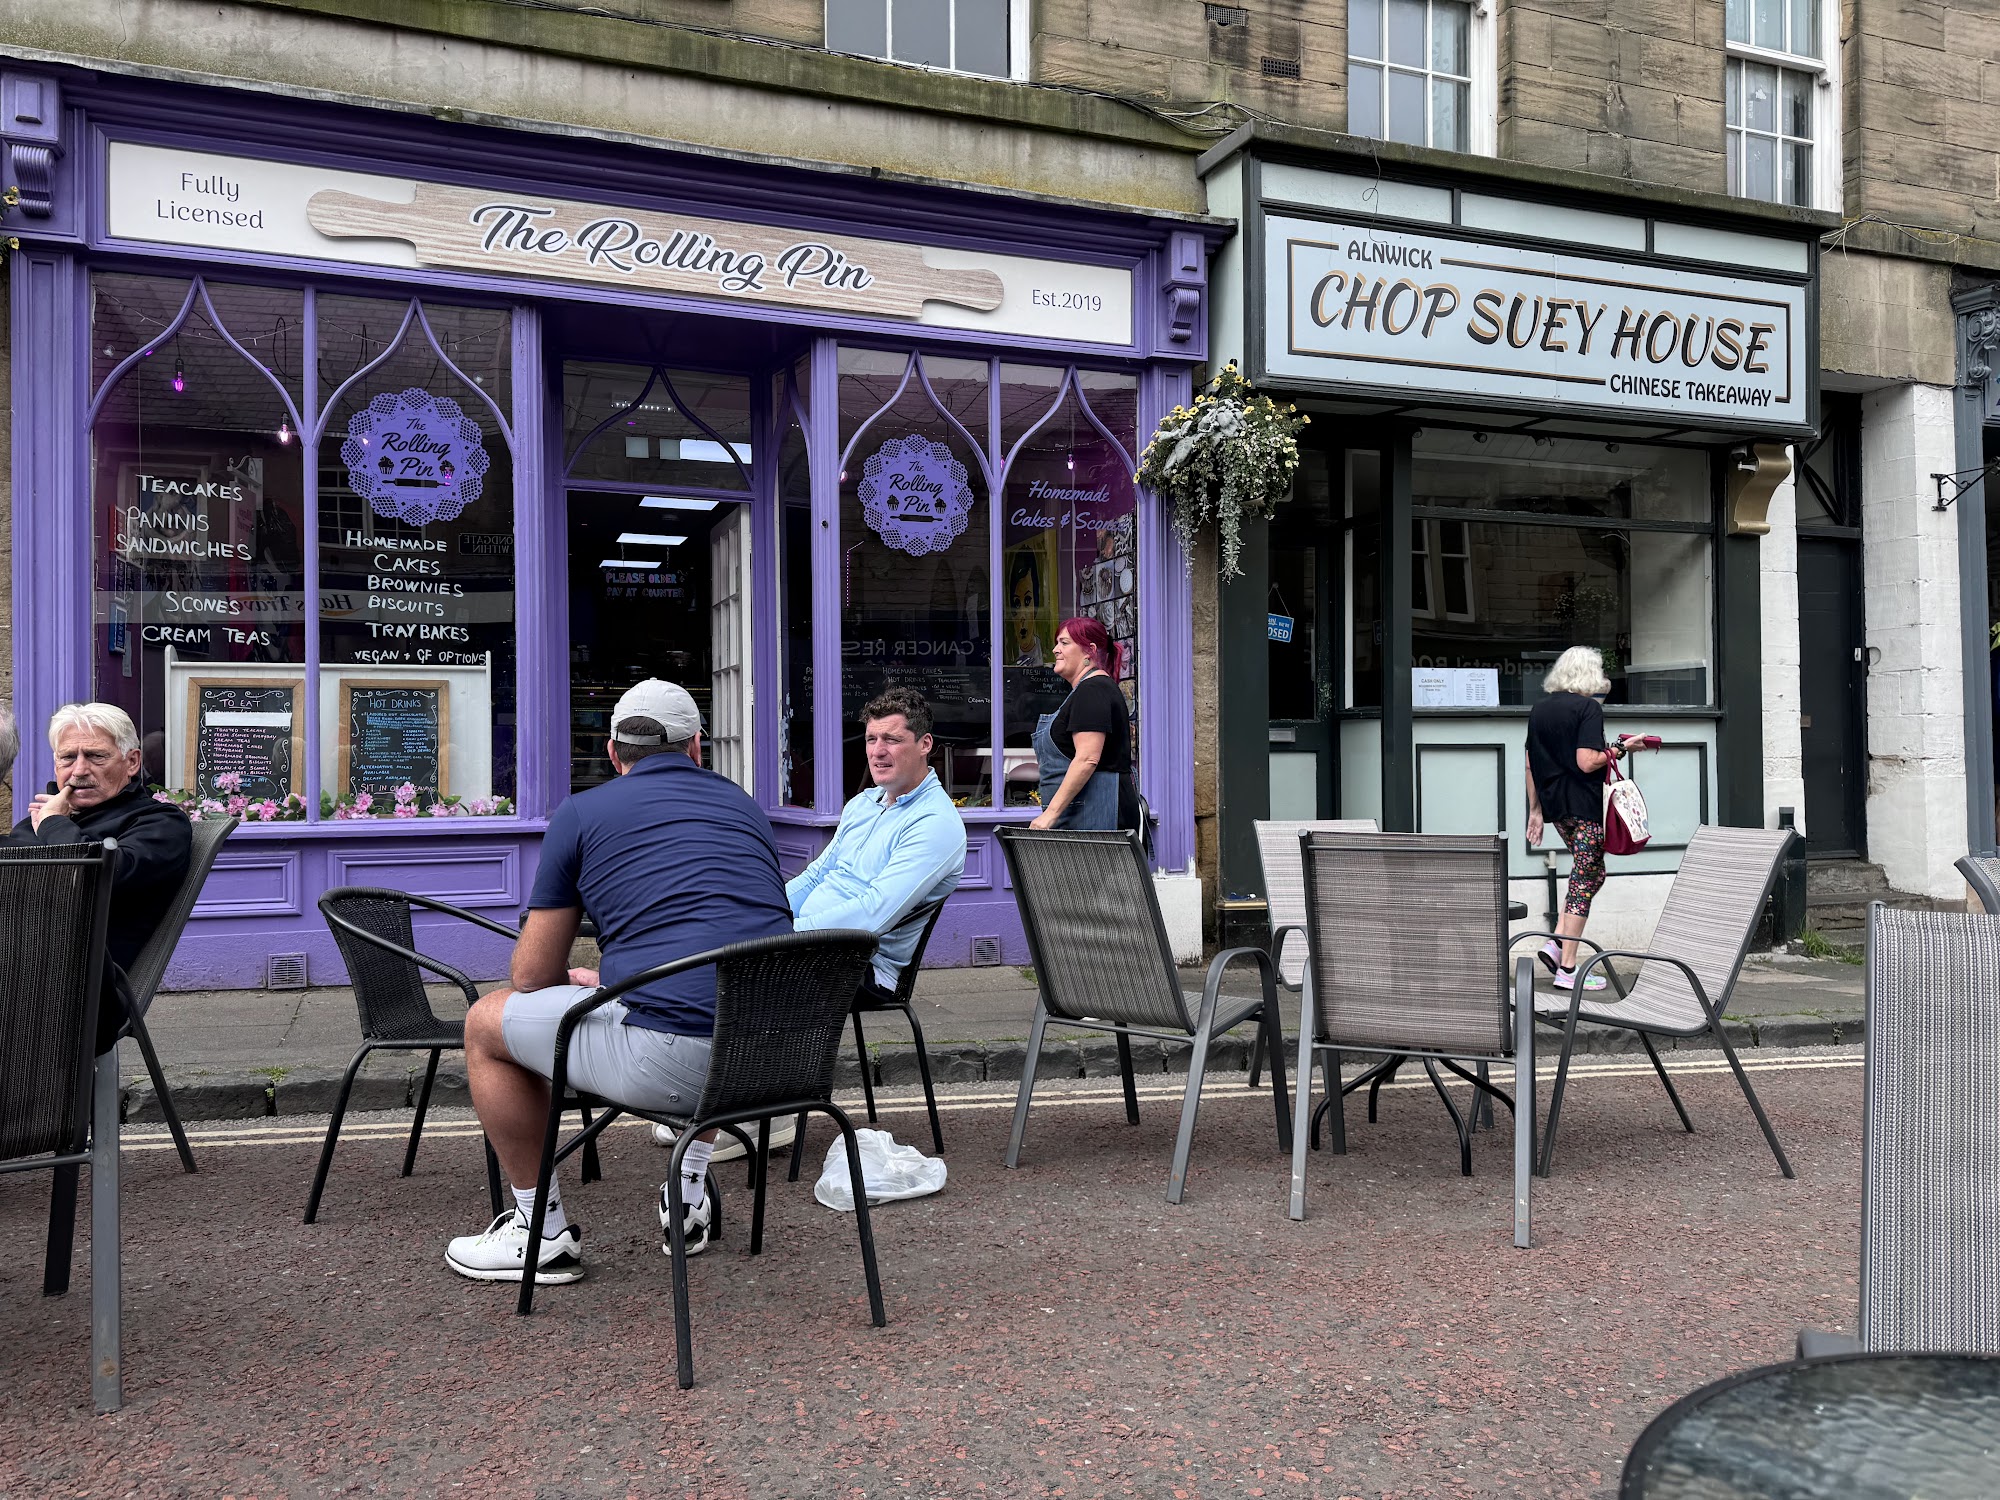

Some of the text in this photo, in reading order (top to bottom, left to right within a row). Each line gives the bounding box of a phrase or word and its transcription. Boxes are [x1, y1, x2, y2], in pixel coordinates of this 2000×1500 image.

[180, 171, 240, 202] Fully
[156, 199, 264, 229] Licensed
[474, 203, 873, 292] The Rolling Pin
[1347, 240, 1433, 270] ALNWICK
[1031, 287, 1103, 312] Est.2019
[1310, 270, 1776, 373] CHOP SUEY HOUSE
[1609, 374, 1772, 408] CHINESE TAKEAWAY
[406, 417, 427, 431] The
[381, 432, 452, 461] Rolling
[399, 457, 434, 477] Pin
[908, 460, 925, 473] The
[135, 474, 243, 502] TEACAKES
[888, 474, 944, 499] Rolling
[1028, 480, 1110, 503] Homemade
[901, 494, 931, 514] Pin
[126, 506, 210, 532] PANINIS
[1010, 508, 1133, 532] Cakes & Scones
[115, 533, 253, 561] SANDWICHES
[345, 530, 448, 552] HOMEMADE
[373, 553, 441, 576] CAKES
[367, 574, 464, 597] BROWNIES
[605, 572, 646, 584] PLEASE
[648, 573, 678, 584] ORDER
[165, 591, 241, 616] SCONES
[606, 587, 622, 597] PAY
[626, 587, 637, 597] AT
[367, 595, 445, 617] BISCUITS
[142, 625, 211, 643] CREAM
[222, 627, 270, 646] TEAS
[354, 650, 399, 665] VEGAN
[416, 649, 432, 664] GF
[438, 650, 487, 666] OPTIONS
[219, 698, 261, 708] TO EAT
[369, 699, 422, 709] HOT DRINKS
[360, 783, 376, 793] SIT
